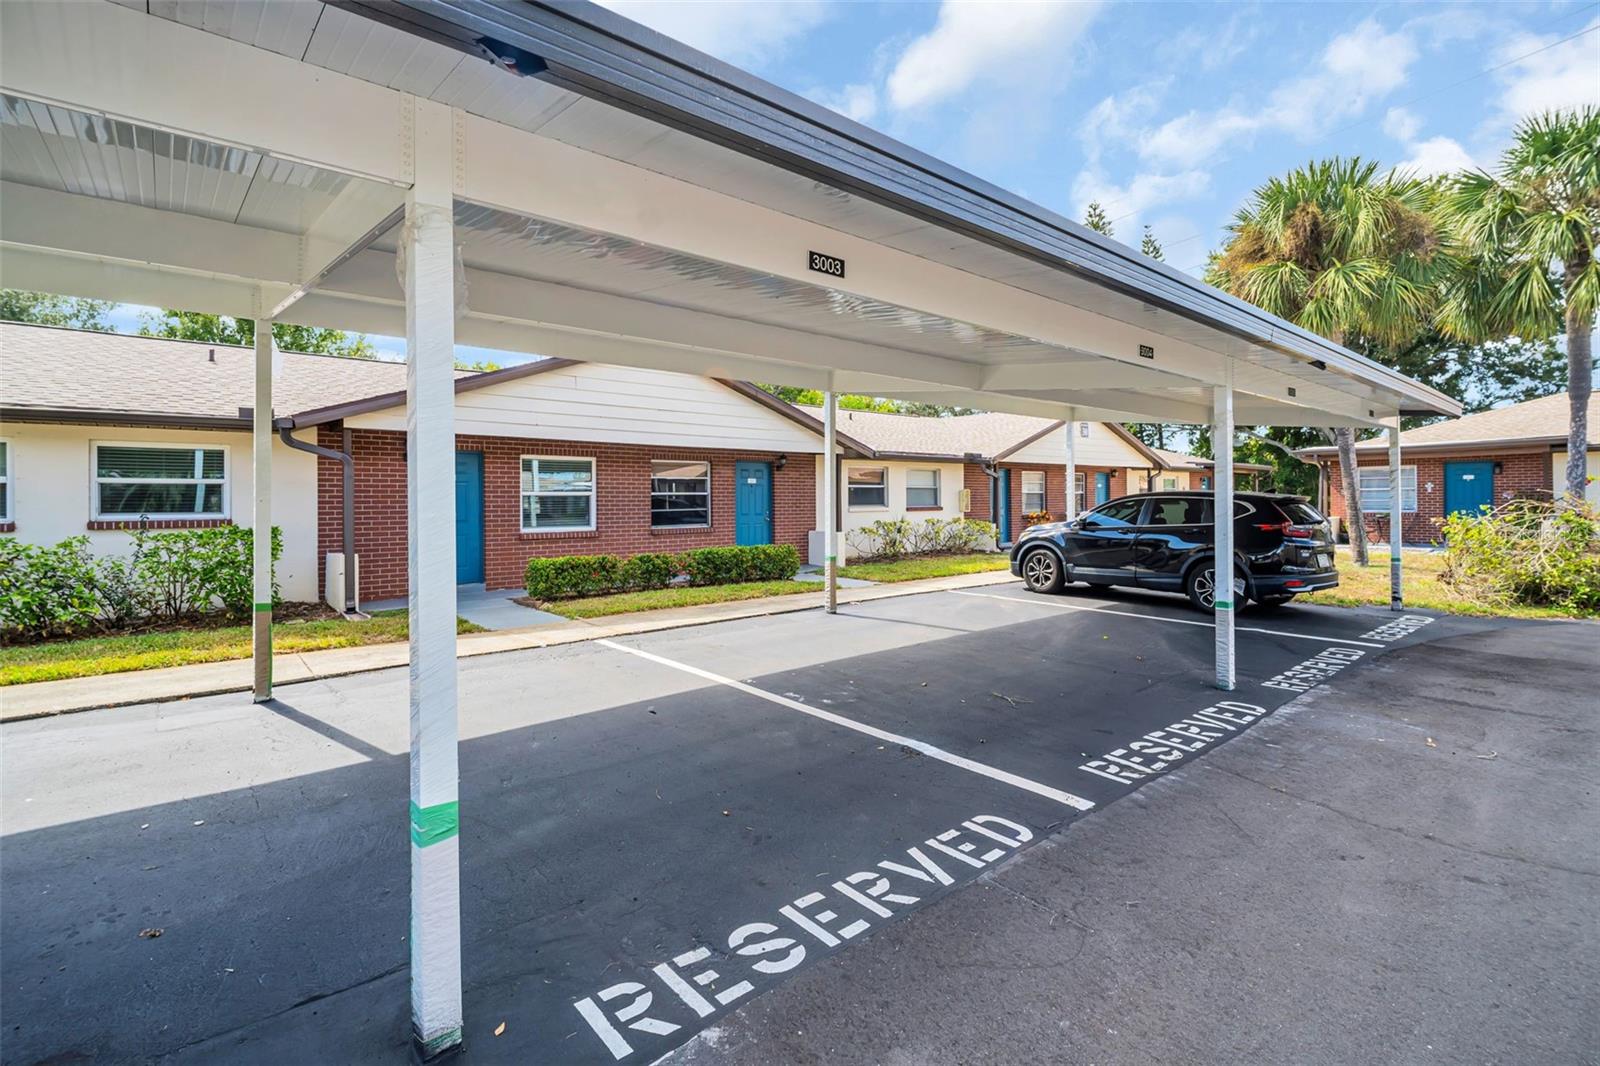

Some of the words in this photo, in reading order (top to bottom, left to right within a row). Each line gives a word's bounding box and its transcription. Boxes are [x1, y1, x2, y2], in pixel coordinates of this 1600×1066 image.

[812, 254, 841, 275] 3003
[1260, 647, 1366, 692] RESERVED
[1078, 700, 1267, 785] RESERVED
[573, 814, 1034, 1061] RESERVED
